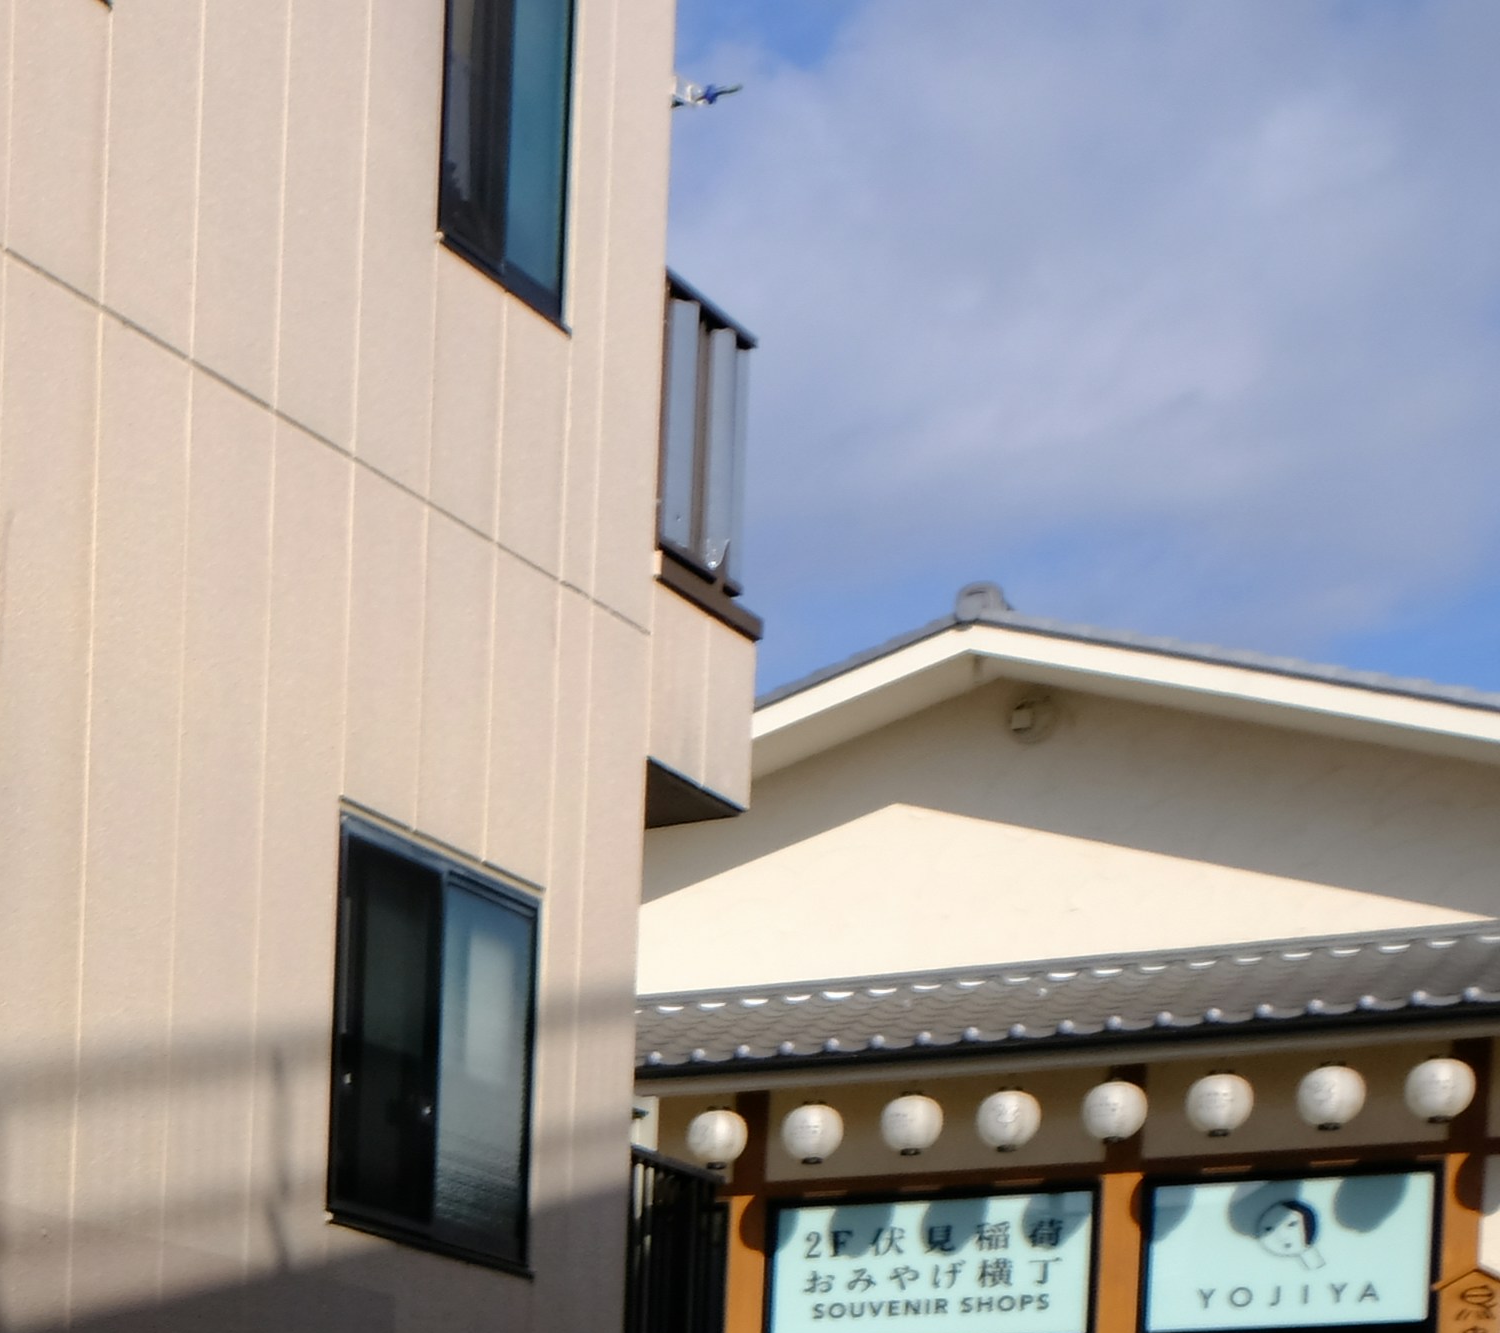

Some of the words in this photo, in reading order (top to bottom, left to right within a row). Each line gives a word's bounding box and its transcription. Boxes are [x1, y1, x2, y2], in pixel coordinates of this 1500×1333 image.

[804, 1229, 853, 1259] 2F
[870, 1218, 1064, 1257] 伏見稲荷
[802, 1257, 1062, 1294] おみやげ横丁
[812, 1299, 949, 1320] SOUVENIR
[960, 1293, 1050, 1313] SHOPS
[1197, 1281, 1380, 1309] YOJIYA
